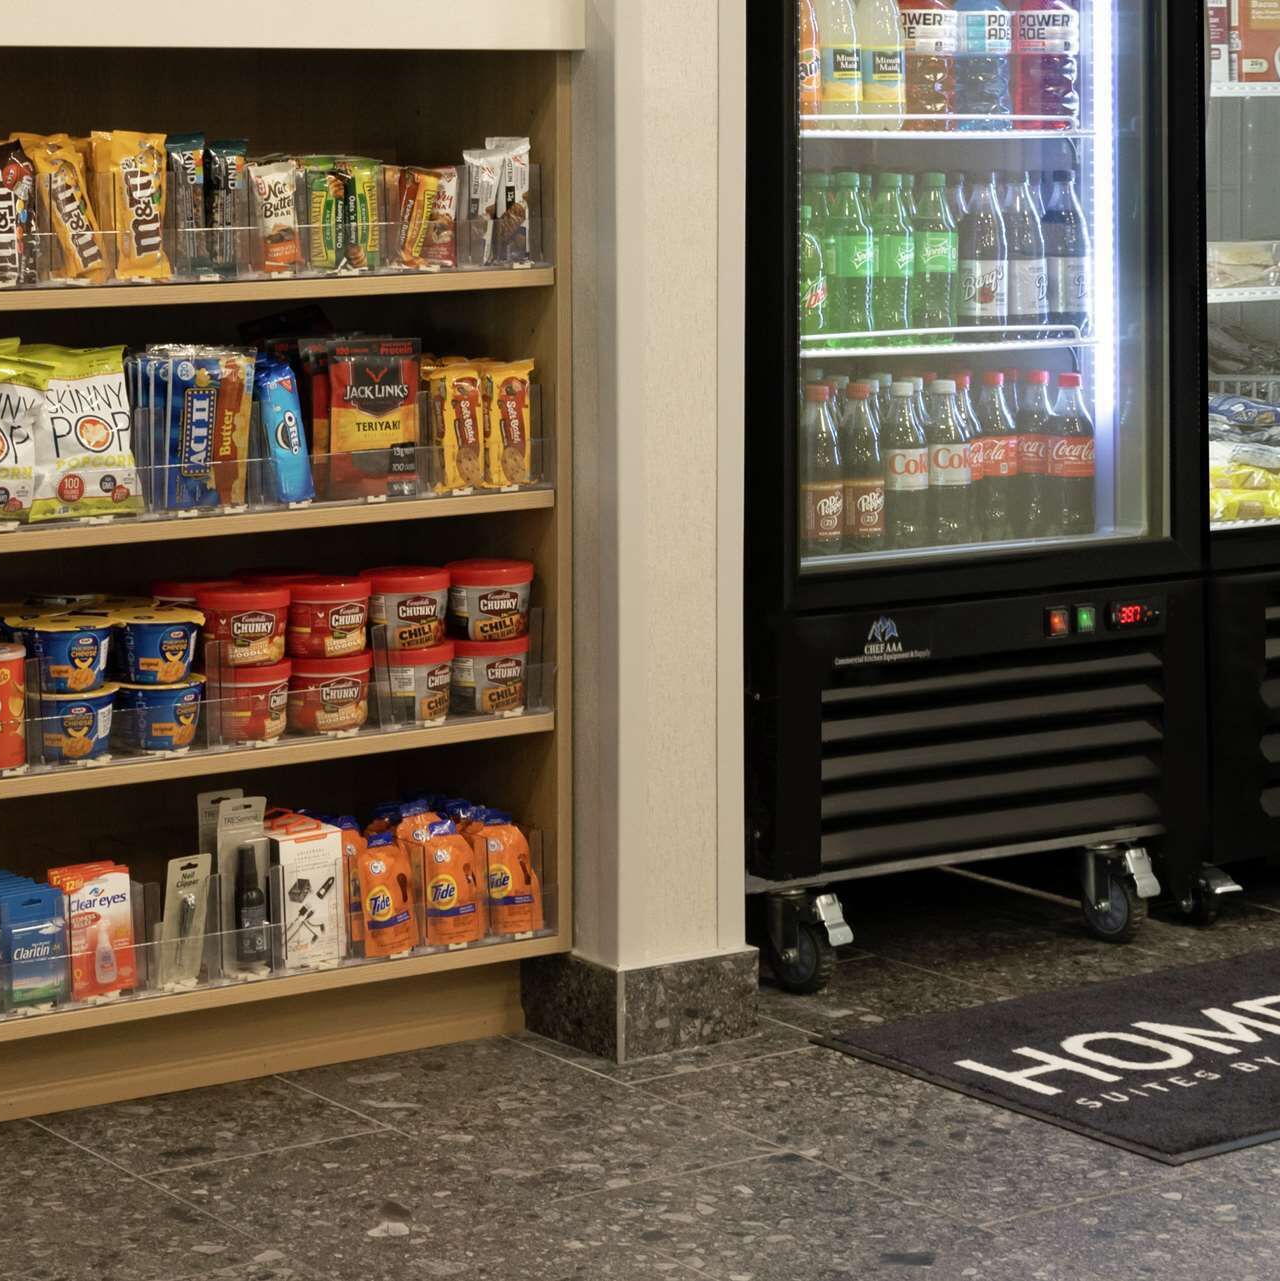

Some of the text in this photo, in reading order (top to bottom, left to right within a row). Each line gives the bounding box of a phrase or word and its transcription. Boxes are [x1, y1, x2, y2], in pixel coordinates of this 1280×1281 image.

[182, 150, 197, 185] KIND
[227, 155, 238, 191] KIND
[264, 180, 287, 201] Nut
[961, 266, 1005, 302] Barq's
[45, 381, 123, 417] SKINNY
[344, 383, 409, 400] JACK LINK'S
[49, 410, 131, 460] POP
[219, 409, 235, 456] Butter
[283, 410, 301, 455] OREO
[355, 420, 401, 433] TERIYAKI
[63, 477, 80, 489] 100
[399, 605, 437, 618] CHUNKY
[480, 598, 518, 612] CHUNKY
[233, 621, 273, 635] CHUNKY
[331, 612, 364, 627] CHUNKY
[480, 618, 514, 634] CHILI
[399, 624, 432, 641] CHILI
[864, 643, 885, 655] CHEF
[488, 666, 521, 679] CHUNKY
[322, 687, 360, 700] CHUNKY
[488, 688, 517, 703] CHILI
[431, 882, 456, 902] Tide
[70, 893, 126, 912] Clear eyes
[370, 894, 391, 916] Tide
[13, 944, 50, 960] Claritin
[1075, 1069, 1222, 1109] SUITES
